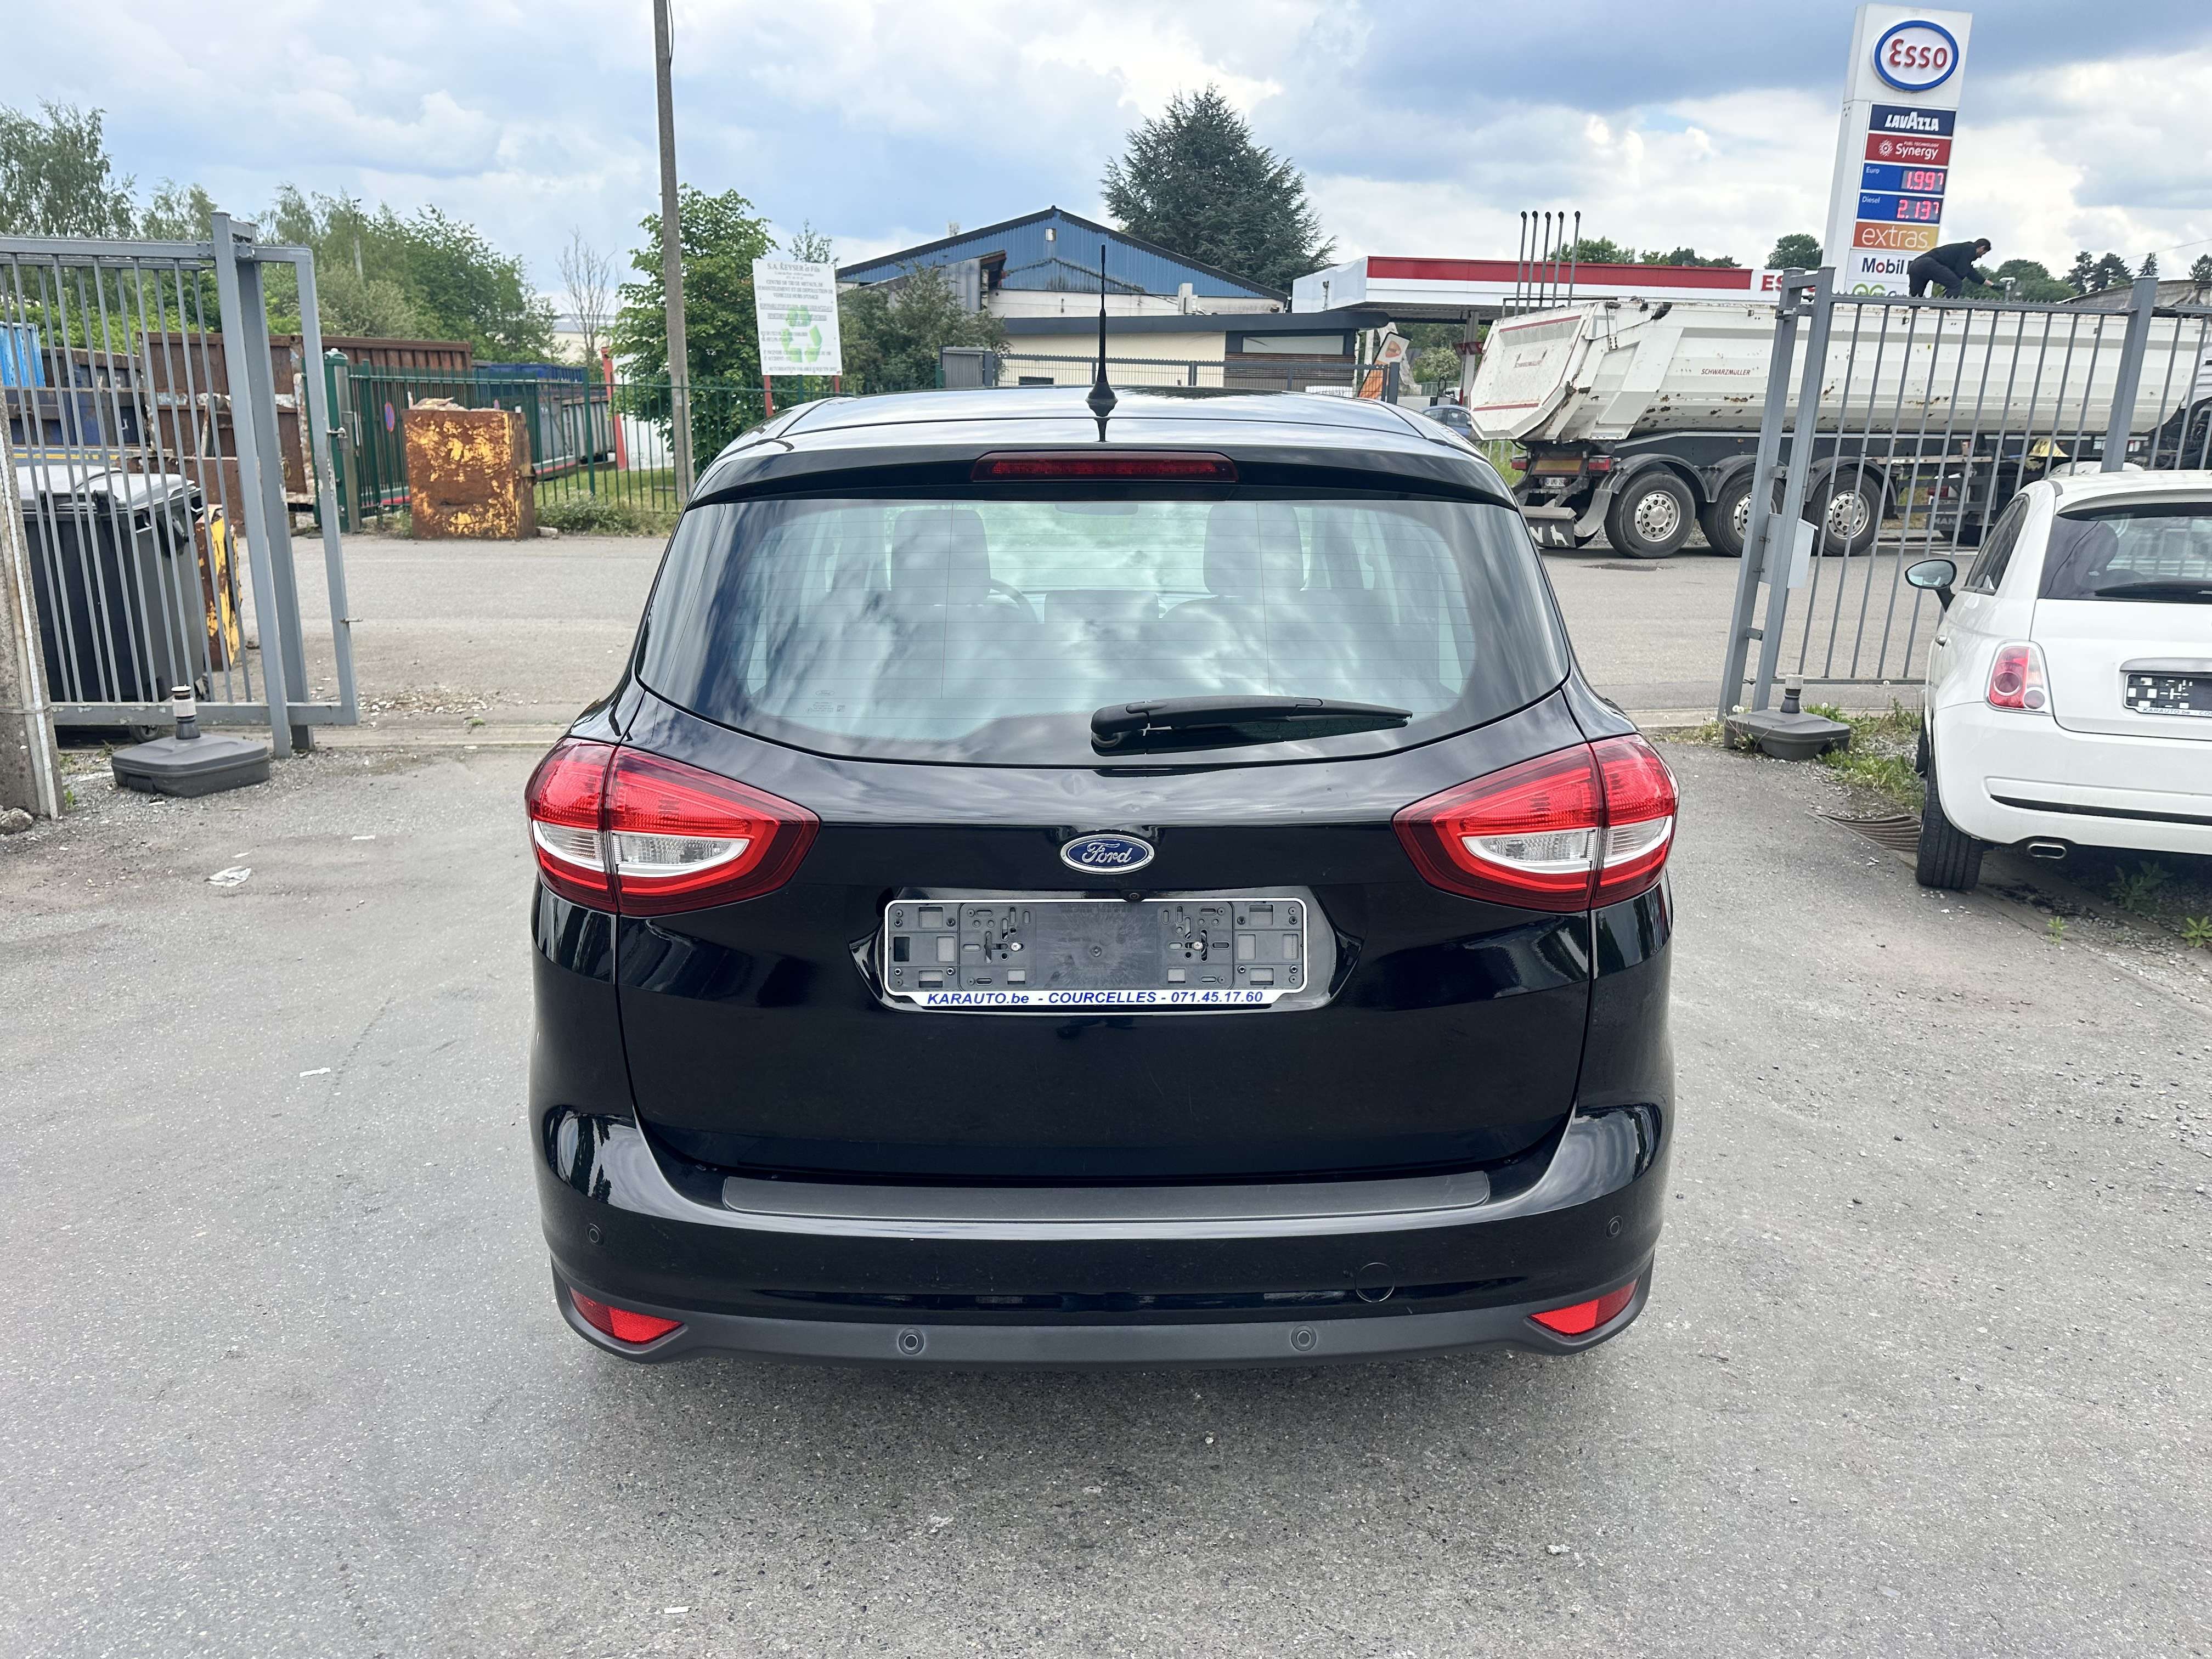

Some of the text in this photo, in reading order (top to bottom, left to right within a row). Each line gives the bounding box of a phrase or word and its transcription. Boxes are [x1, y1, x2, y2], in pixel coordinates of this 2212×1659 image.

[1884, 111, 1939, 131] LAVAZZA
[1895, 143, 1939, 160] Synergy
[1866, 166, 1880, 174] Euro
[1862, 196, 1881, 204] Diesel
[1861, 225, 1928, 249] extras
[1861, 257, 1904, 275] Mobil
[1081, 842, 1133, 863] Ford
[927, 993, 1029, 1005] KARAUTO.be
[1048, 992, 1156, 1003] COURCELLES
[1171, 991, 1263, 1003] 071.45.17.60
